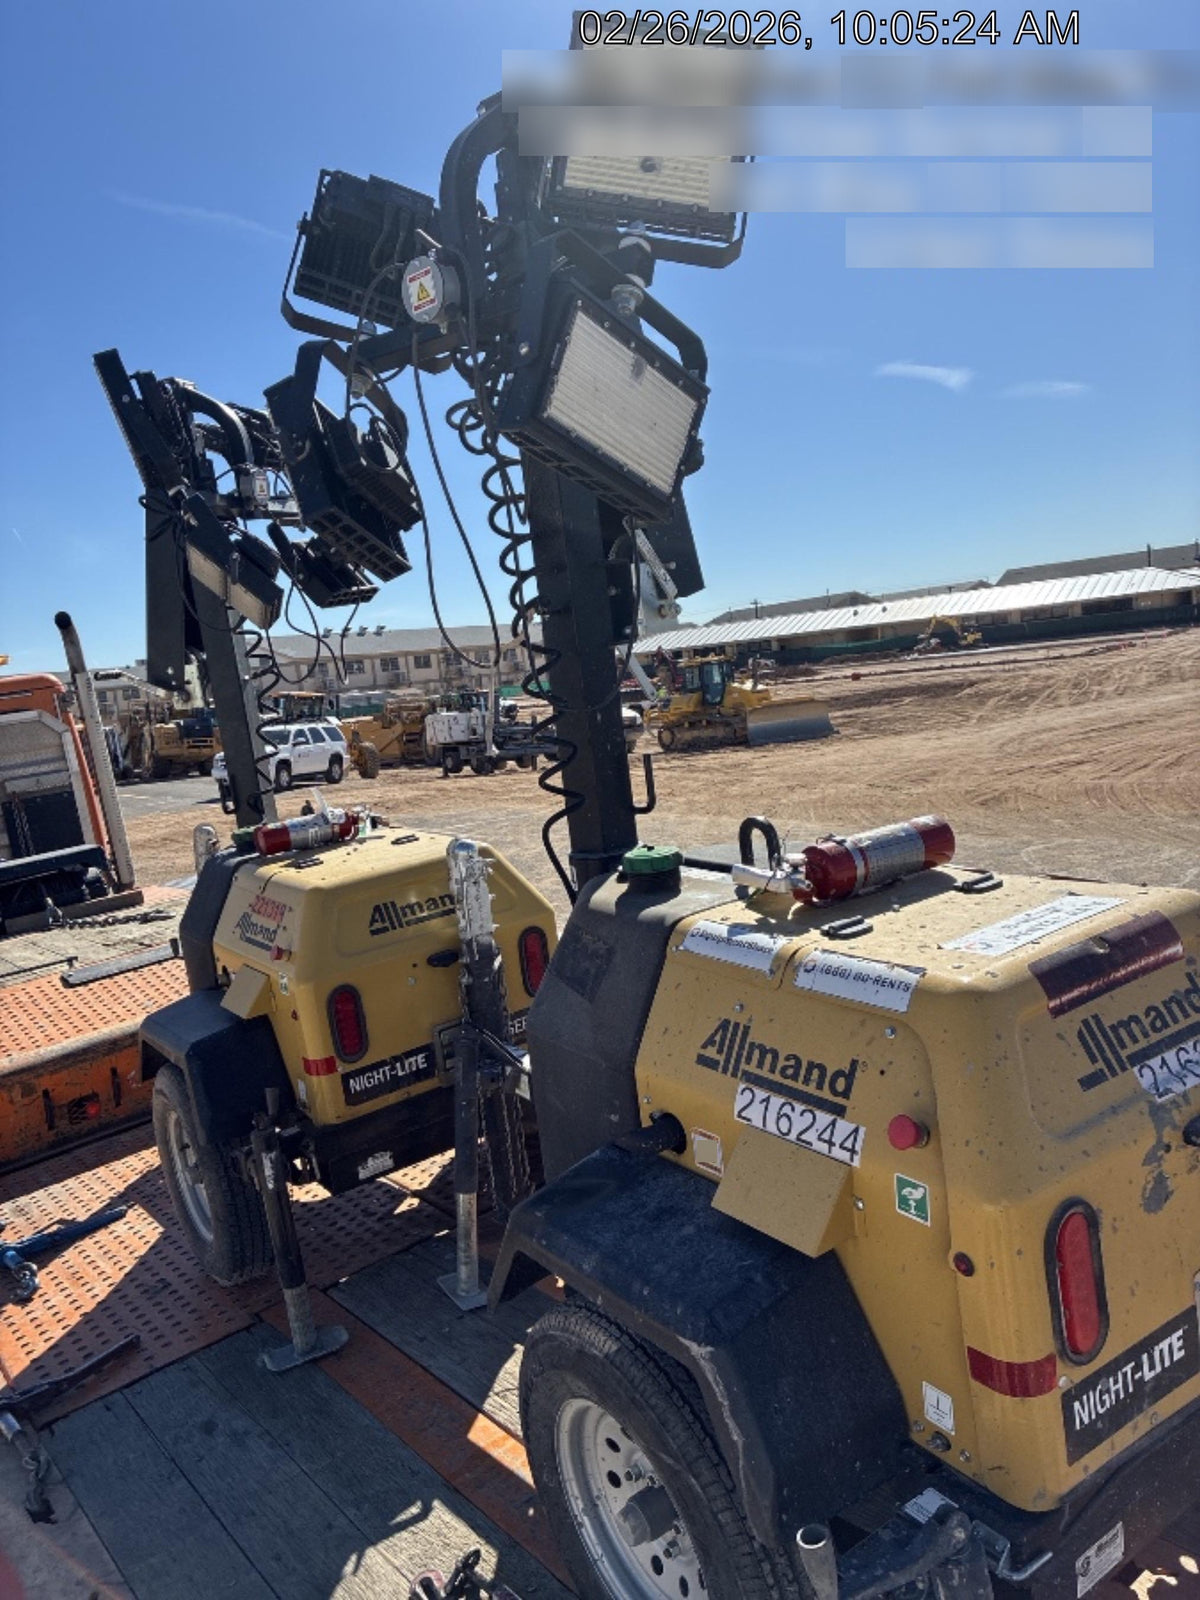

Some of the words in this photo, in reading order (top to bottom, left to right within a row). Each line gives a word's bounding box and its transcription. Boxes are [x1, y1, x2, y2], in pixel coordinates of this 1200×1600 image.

[369, 894, 455, 931] Allman
[349, 1053, 428, 1095] NIGHT-LITE
[701, 1017, 859, 1101] Allmand
[737, 1087, 860, 1164] 216244
[1073, 1328, 1185, 1431] NIGHT-LITE
